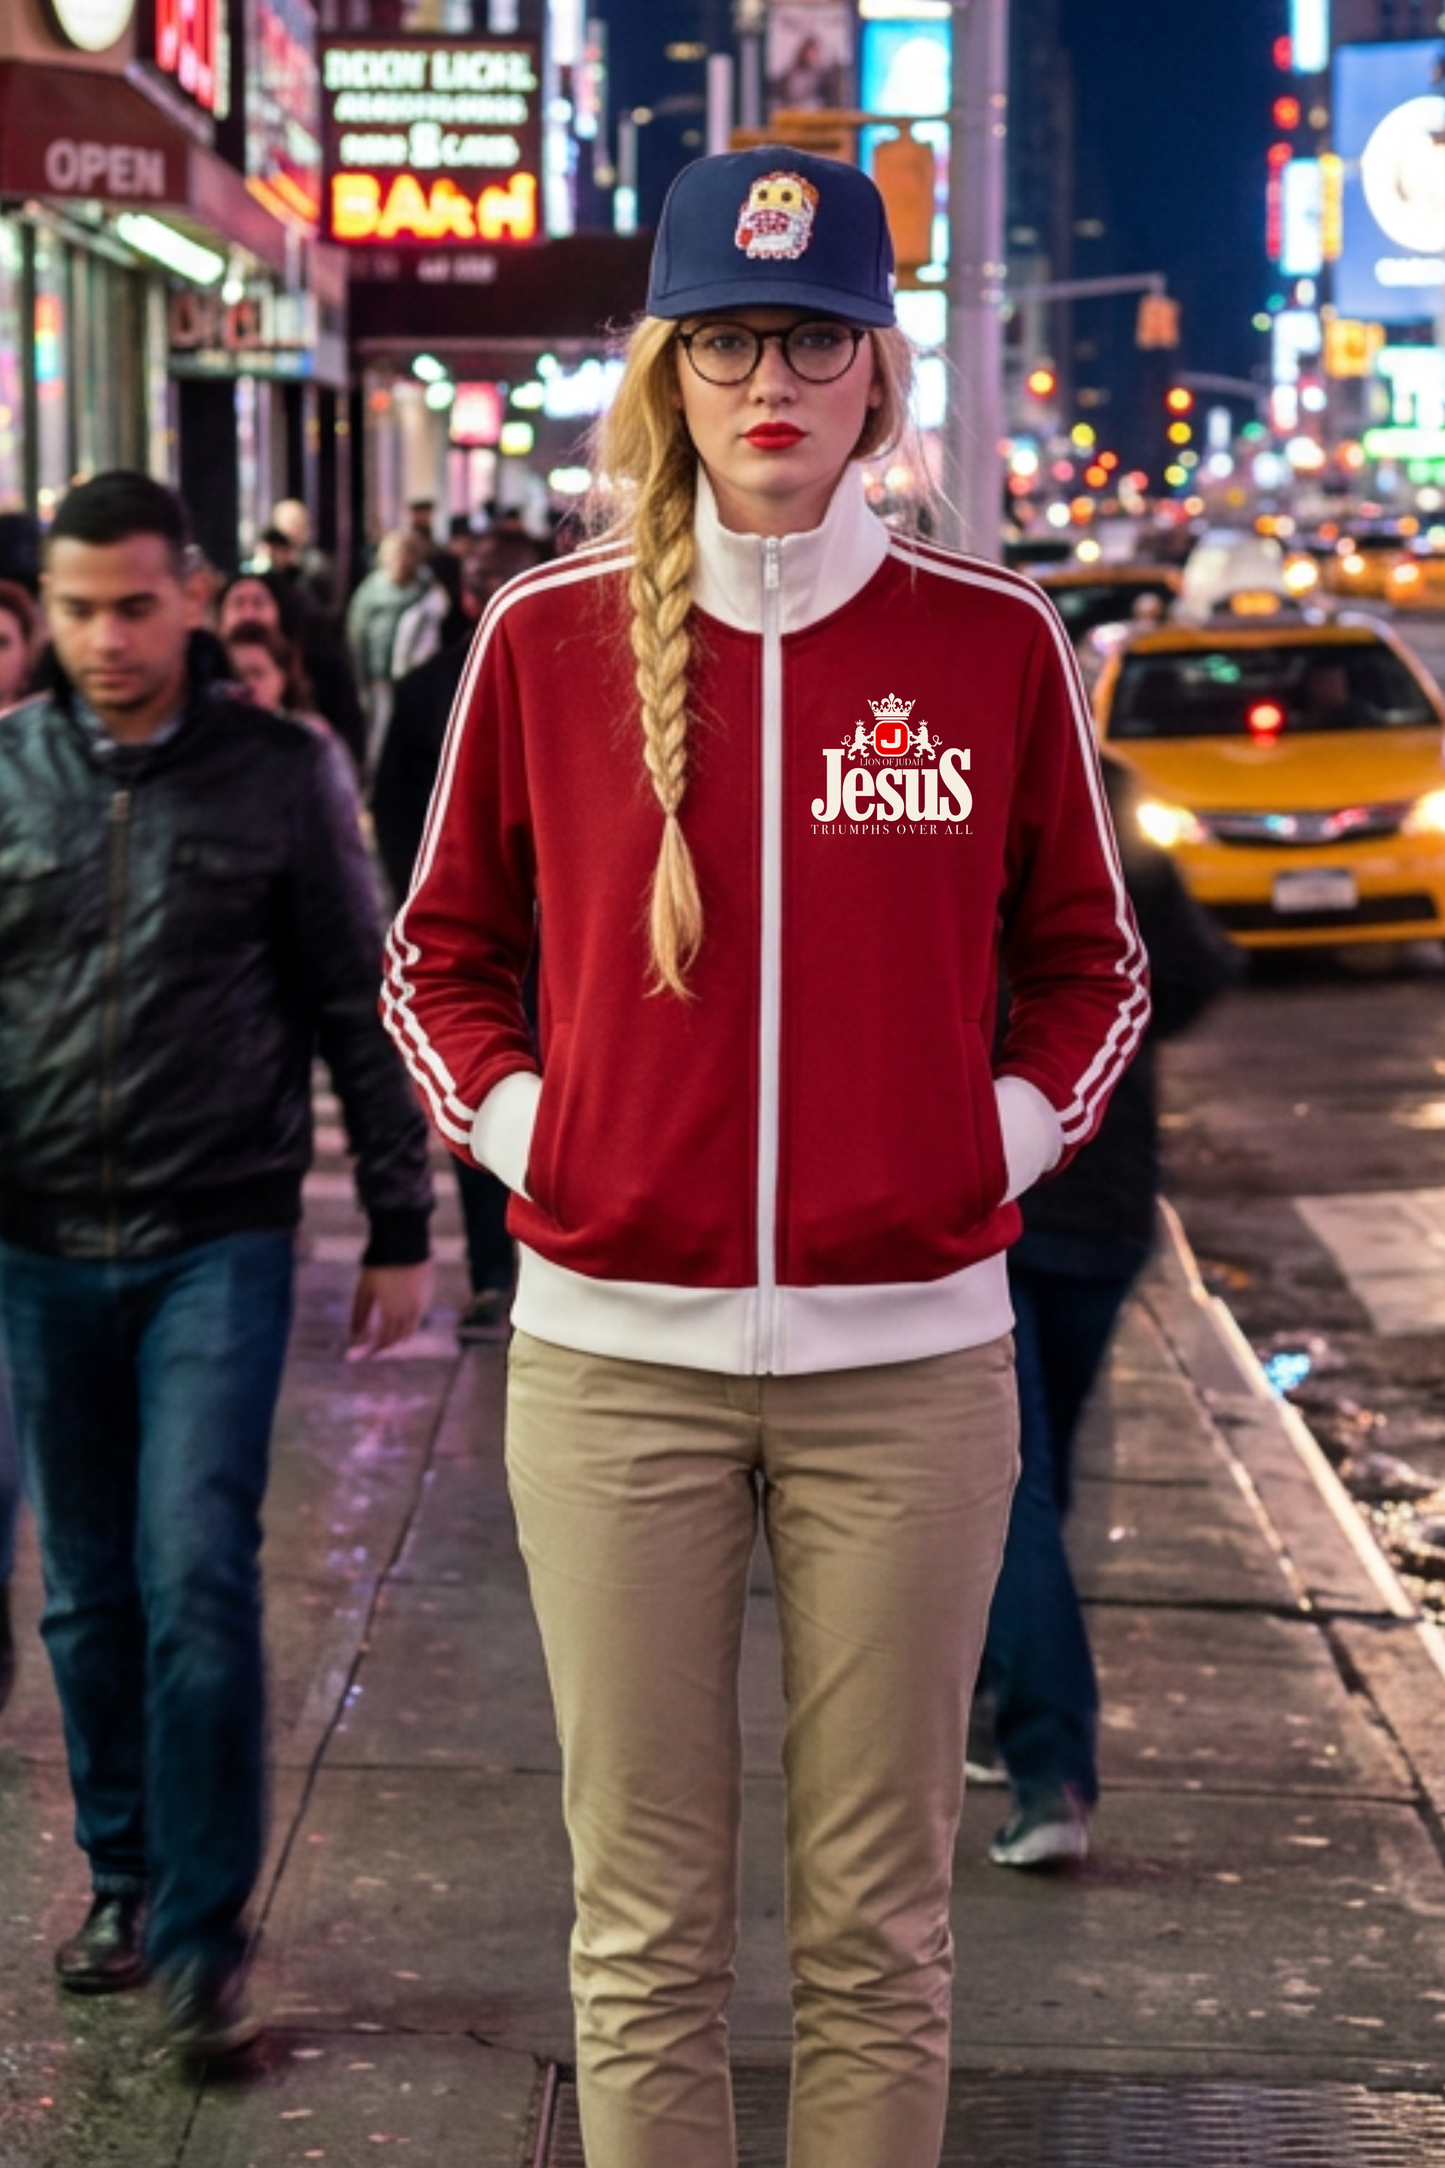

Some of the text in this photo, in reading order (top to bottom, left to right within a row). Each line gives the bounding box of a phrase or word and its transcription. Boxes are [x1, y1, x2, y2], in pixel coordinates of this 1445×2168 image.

[44, 139, 165, 196] OPEN
[881, 729, 901, 748] J
[860, 758, 924, 767] LION OF JUDAH
[810, 824, 974, 835] TRIUMPHS OVER ALL
